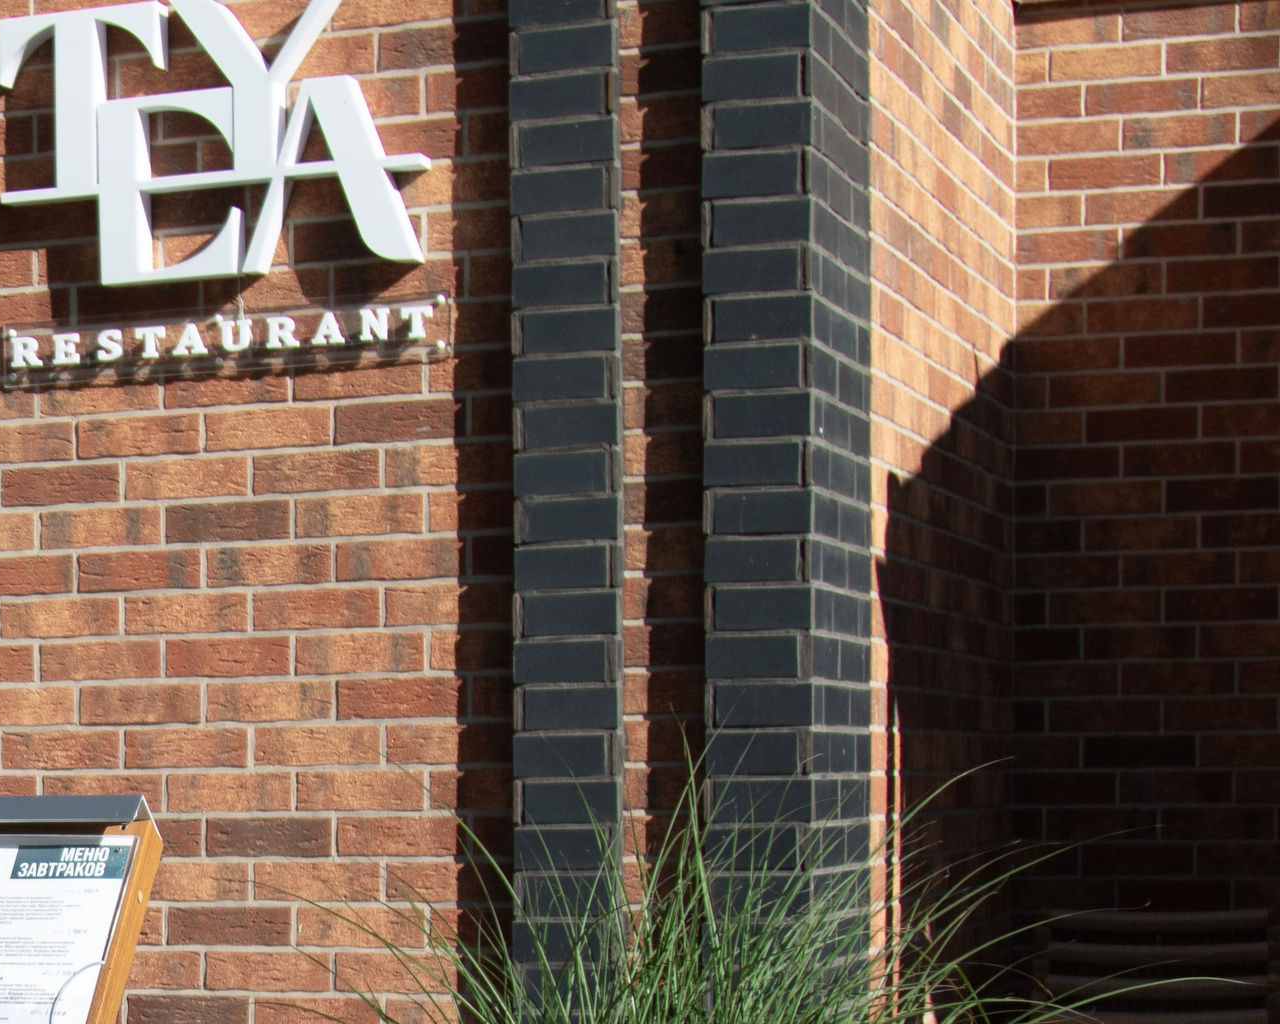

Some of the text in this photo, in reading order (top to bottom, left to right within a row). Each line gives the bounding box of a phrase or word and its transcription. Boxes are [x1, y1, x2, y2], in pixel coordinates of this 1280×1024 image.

[9, 305, 434, 369] RESTAURANT
[61, 847, 110, 862] МЕНЮ
[18, 862, 106, 877] ЗАВТРАКОВ
